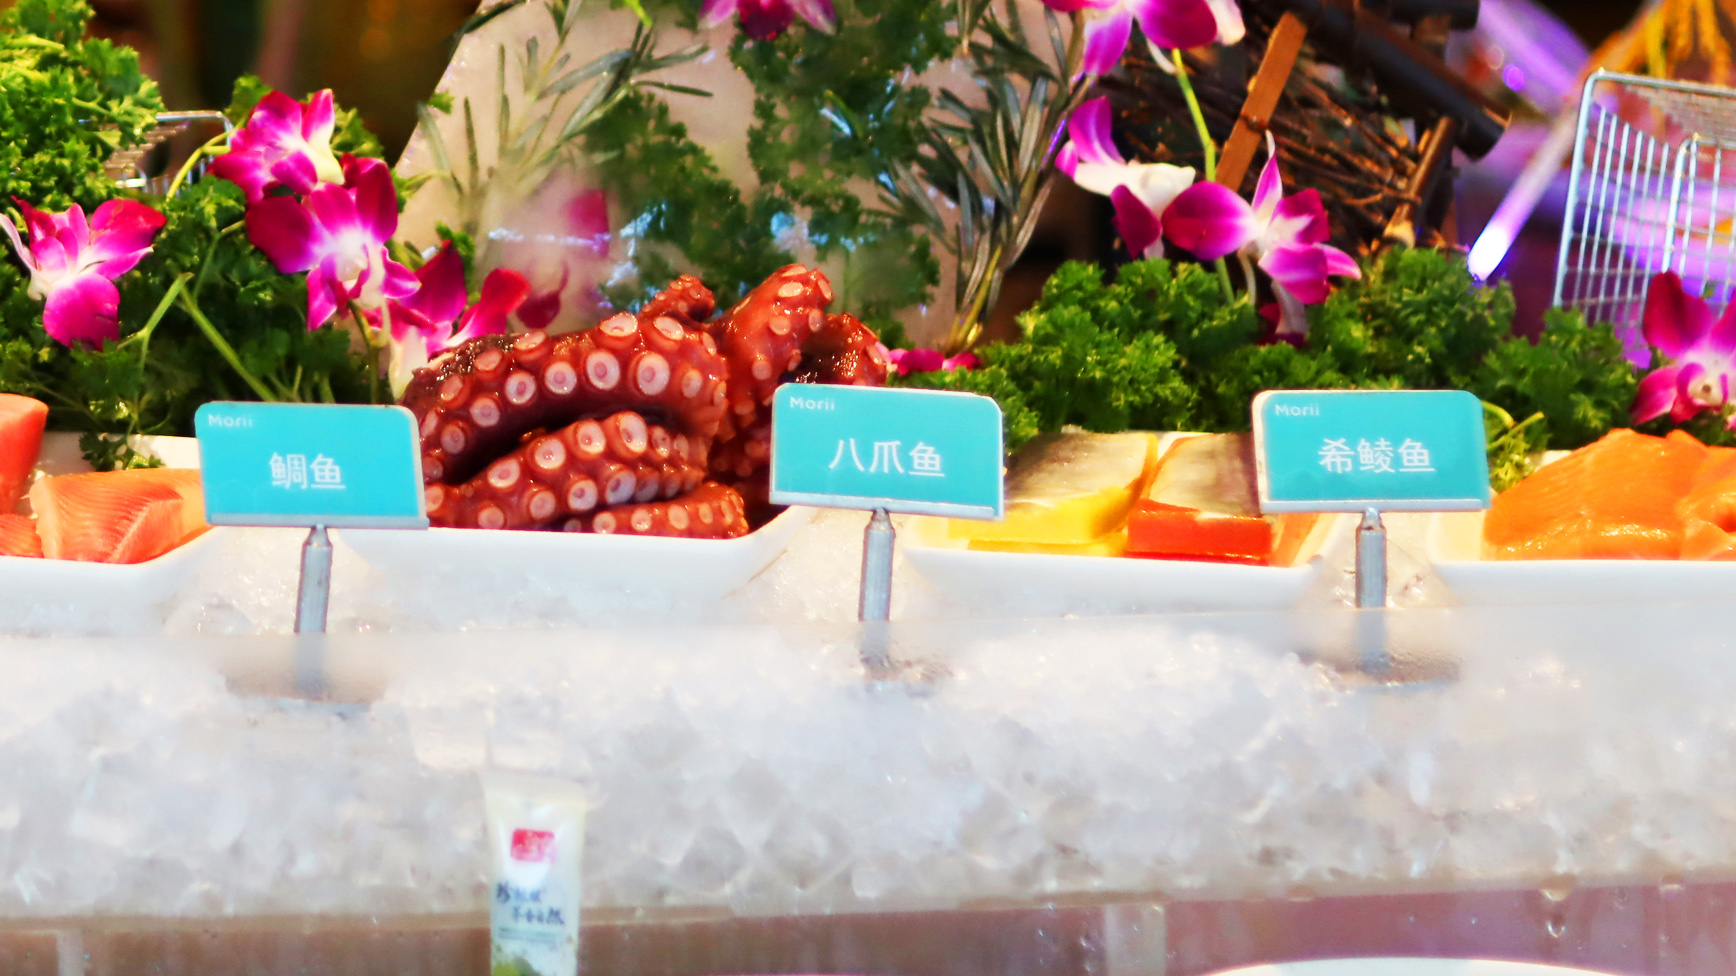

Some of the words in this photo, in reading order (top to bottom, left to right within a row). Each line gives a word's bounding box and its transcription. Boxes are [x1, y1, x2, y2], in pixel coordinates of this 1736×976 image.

[789, 396, 835, 411] Morii
[1274, 404, 1320, 417] Morii
[207, 413, 253, 427] Morii
[828, 438, 945, 477] 八爪鱼
[1318, 437, 1436, 474] 希鲮鱼
[269, 452, 346, 489] 鲷鱼
